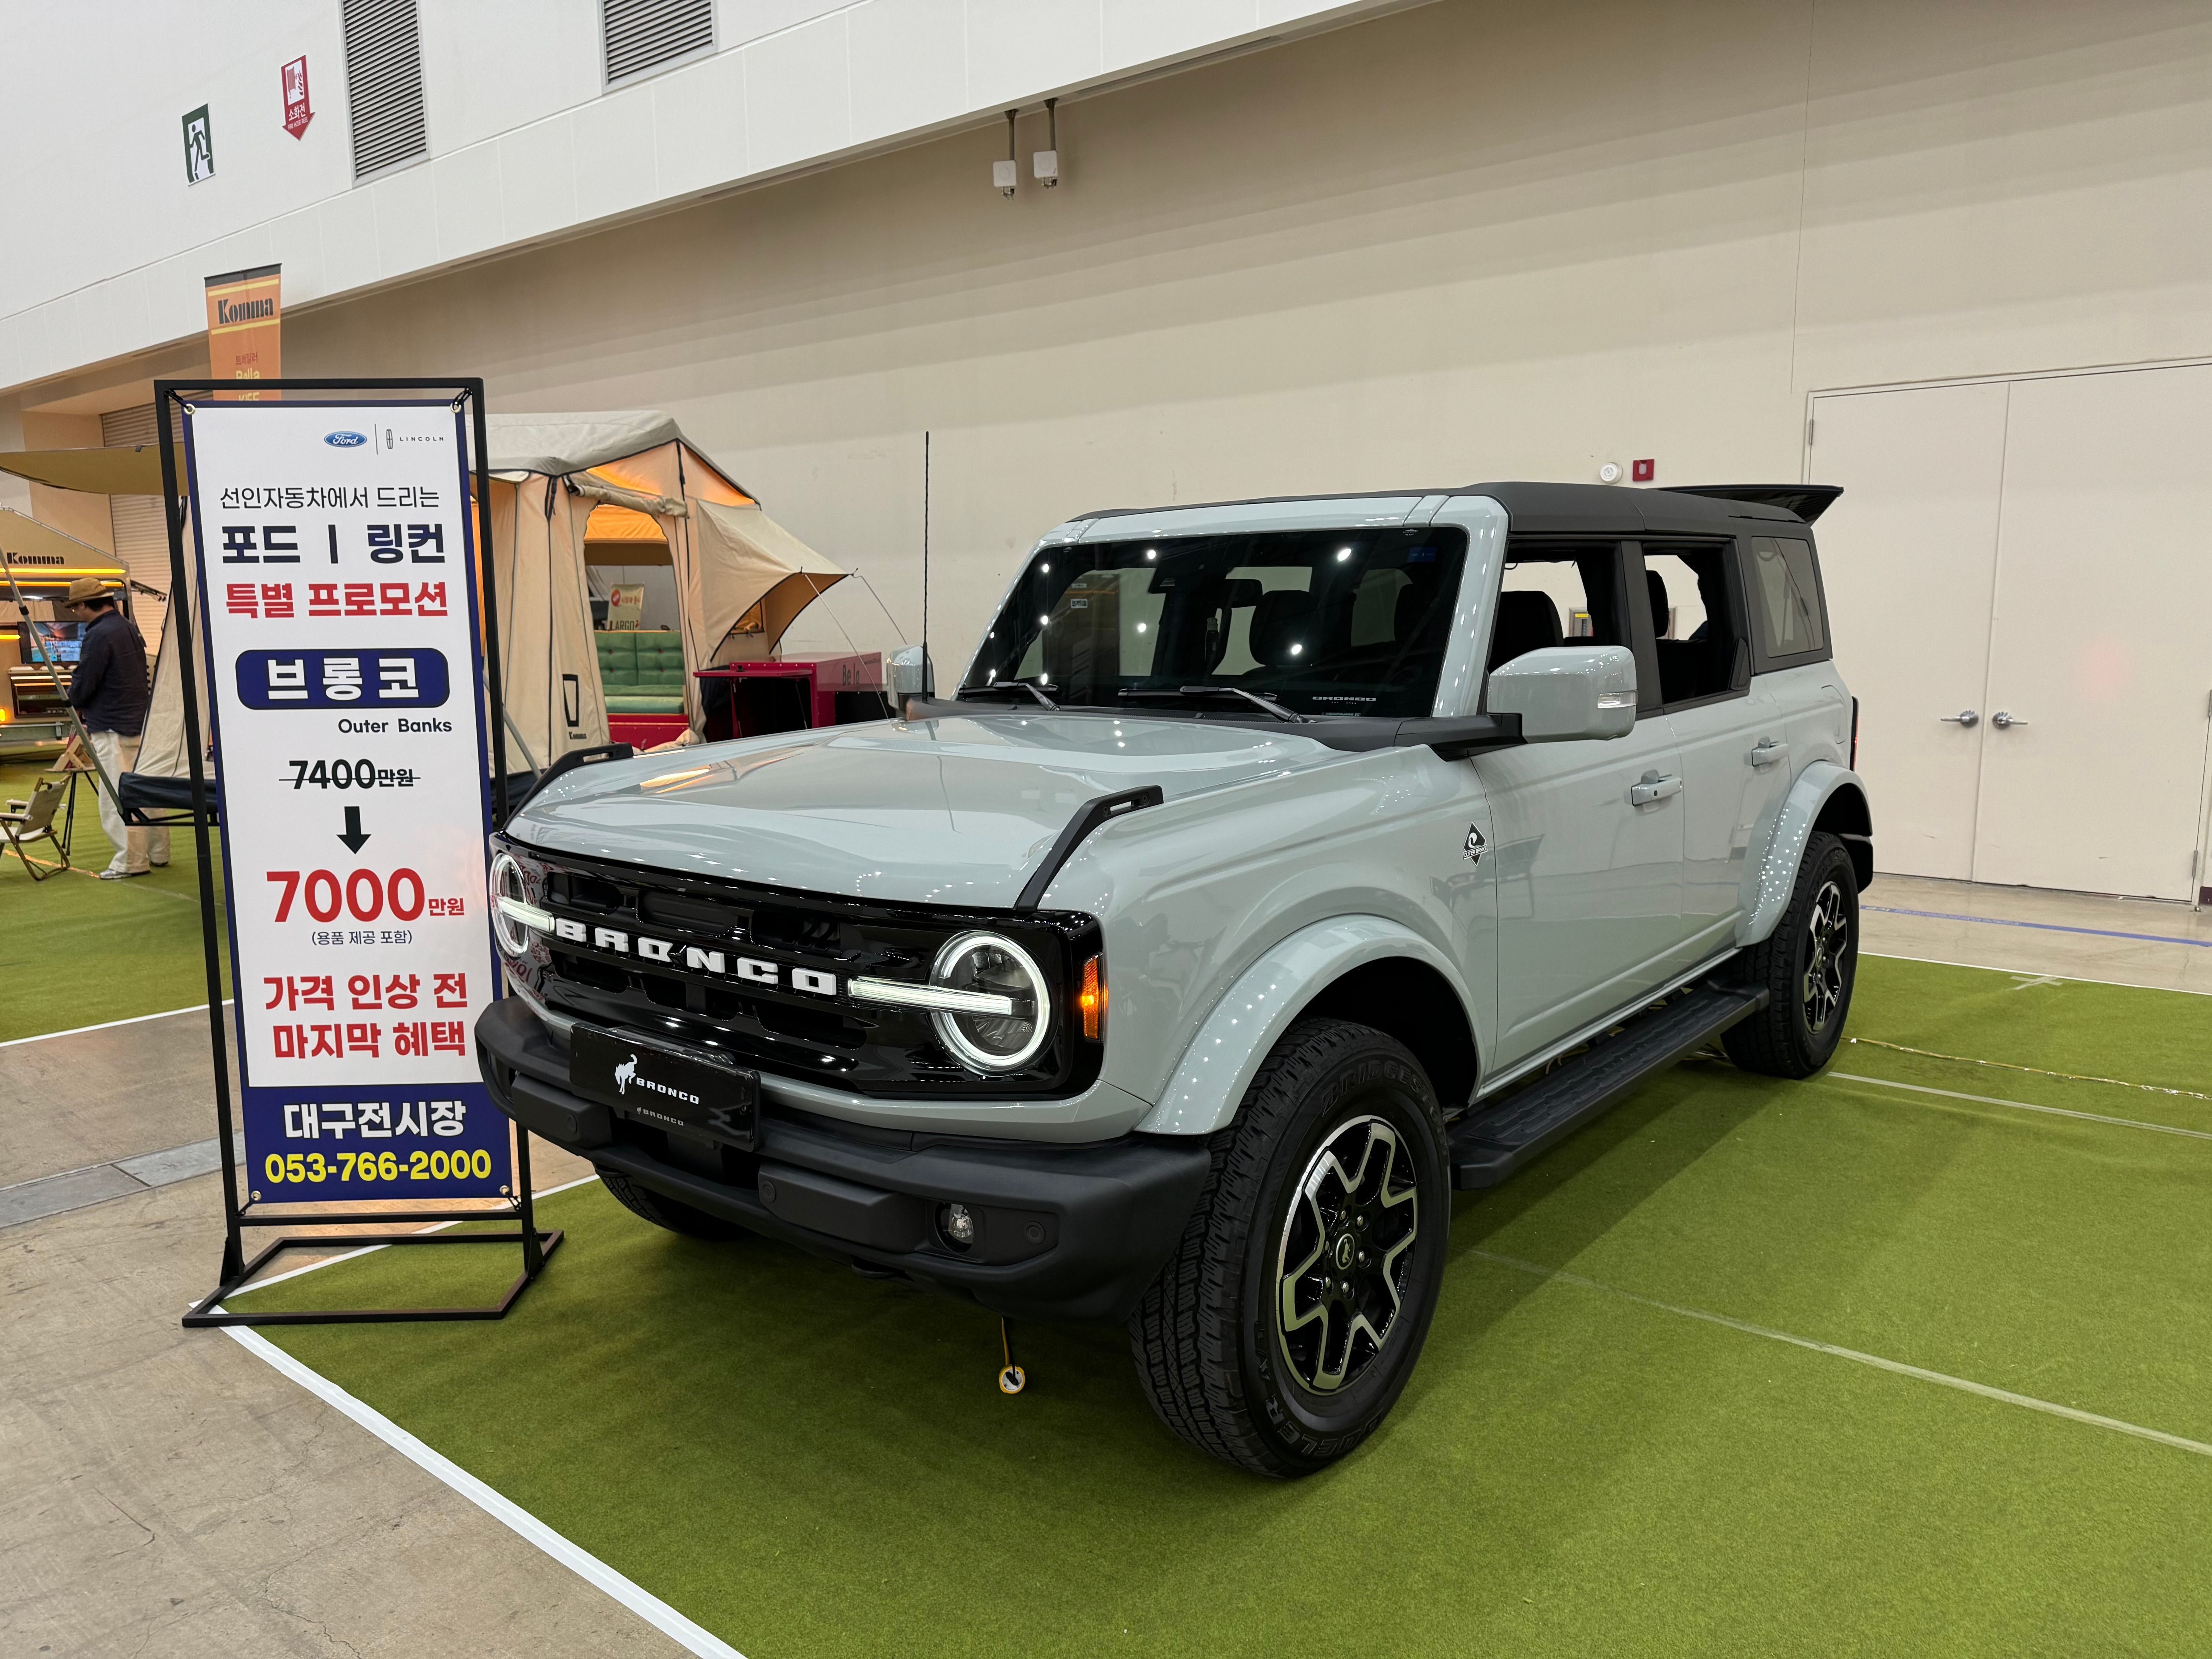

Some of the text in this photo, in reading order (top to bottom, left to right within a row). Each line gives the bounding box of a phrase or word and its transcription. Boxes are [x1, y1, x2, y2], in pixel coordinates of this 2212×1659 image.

[289, 102, 306, 121] 소화전
[218, 298, 273, 324] Komma
[333, 433, 358, 446] Ford
[221, 487, 440, 509] 선인자동차에서 드리는
[222, 526, 301, 564] 포드
[367, 524, 445, 564] 링컨
[7, 552, 64, 565] Komma
[227, 582, 448, 619] 특별 프로모션
[338, 718, 452, 734] Outer Banks
[312, 930, 412, 946] (용품 제공 포함)
[556, 917, 836, 996] BRONCO
[264, 973, 468, 1012] 가격 인상 전
[273, 1021, 466, 1059] 마지막 혜택
[636, 1077, 699, 1104] BRONCO
[284, 1101, 467, 1139] 대구전시장
[643, 1108, 684, 1126] BRONCO
[266, 1149, 491, 1183] 053-766-2000
